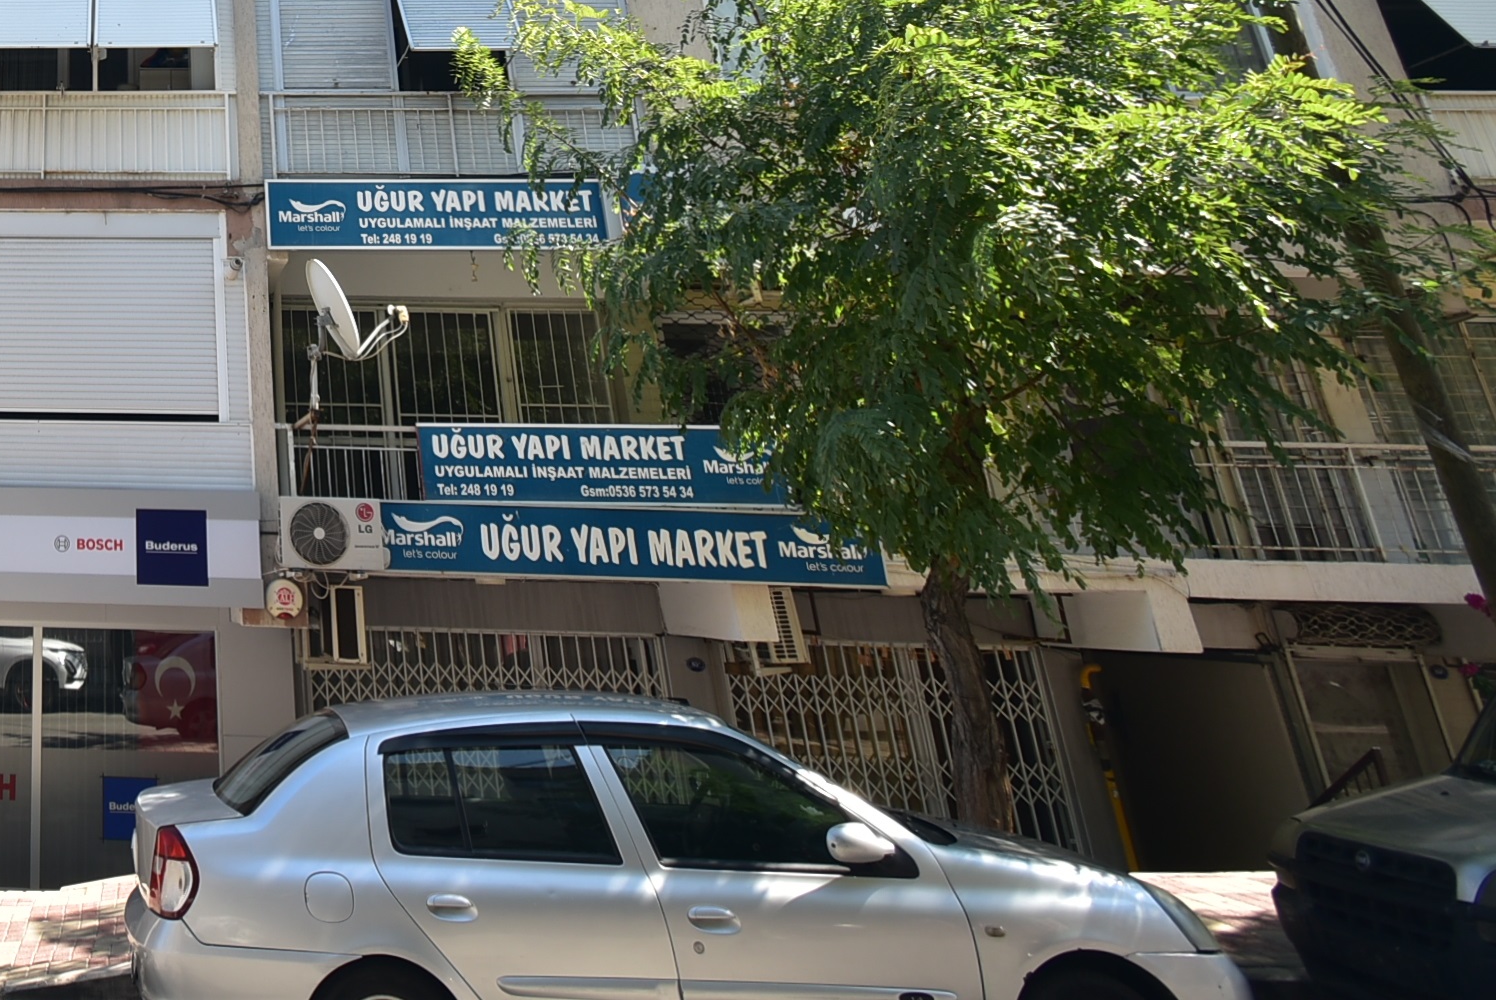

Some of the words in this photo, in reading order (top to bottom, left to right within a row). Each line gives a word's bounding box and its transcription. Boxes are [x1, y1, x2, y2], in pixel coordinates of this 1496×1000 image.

[357, 185, 424, 213] UĞUR
[432, 189, 486, 213] YAPI
[494, 189, 592, 213] MARKET
[278, 210, 340, 223] Marshall
[359, 217, 445, 229] UYGULAMALI
[449, 216, 497, 231] İNŞAAT
[502, 215, 597, 228] MALZEMELERİ
[297, 224, 314, 232] let's
[315, 224, 340, 232] colour
[361, 233, 380, 244] Tel:
[382, 233, 401, 244] 248
[404, 233, 417, 244] 19
[420, 233, 432, 244] 19
[431, 427, 505, 459] UĞUR
[511, 433, 571, 461] YAPI
[579, 435, 685, 461] MARKET
[434, 465, 528, 478] UYGULAMALI
[532, 463, 584, 481] İNŞAAT
[589, 464, 691, 480] MALZEMELERİ
[726, 476, 744, 485] let's
[437, 483, 458, 496] Tel:
[460, 484, 481, 496] 248
[484, 484, 498, 496] 19
[501, 484, 514, 496] 19
[580, 485, 637, 498] Gsm:0536
[639, 486, 659, 498] 573
[662, 486, 677, 498] 54
[679, 486, 694, 498] 34
[358, 524, 373, 534] LG
[76, 538, 123, 551] BOSCH
[384, 529, 457, 547] Marshall
[480, 513, 564, 562] UĞUR
[570, 523, 638, 566] YAPI
[647, 528, 768, 569] MARKET
[145, 540, 198, 552] Buderus
[403, 549, 423, 559] let's
[425, 549, 457, 560] colour
[806, 562, 827, 572] let's
[108, 801, 136, 811] Bude
